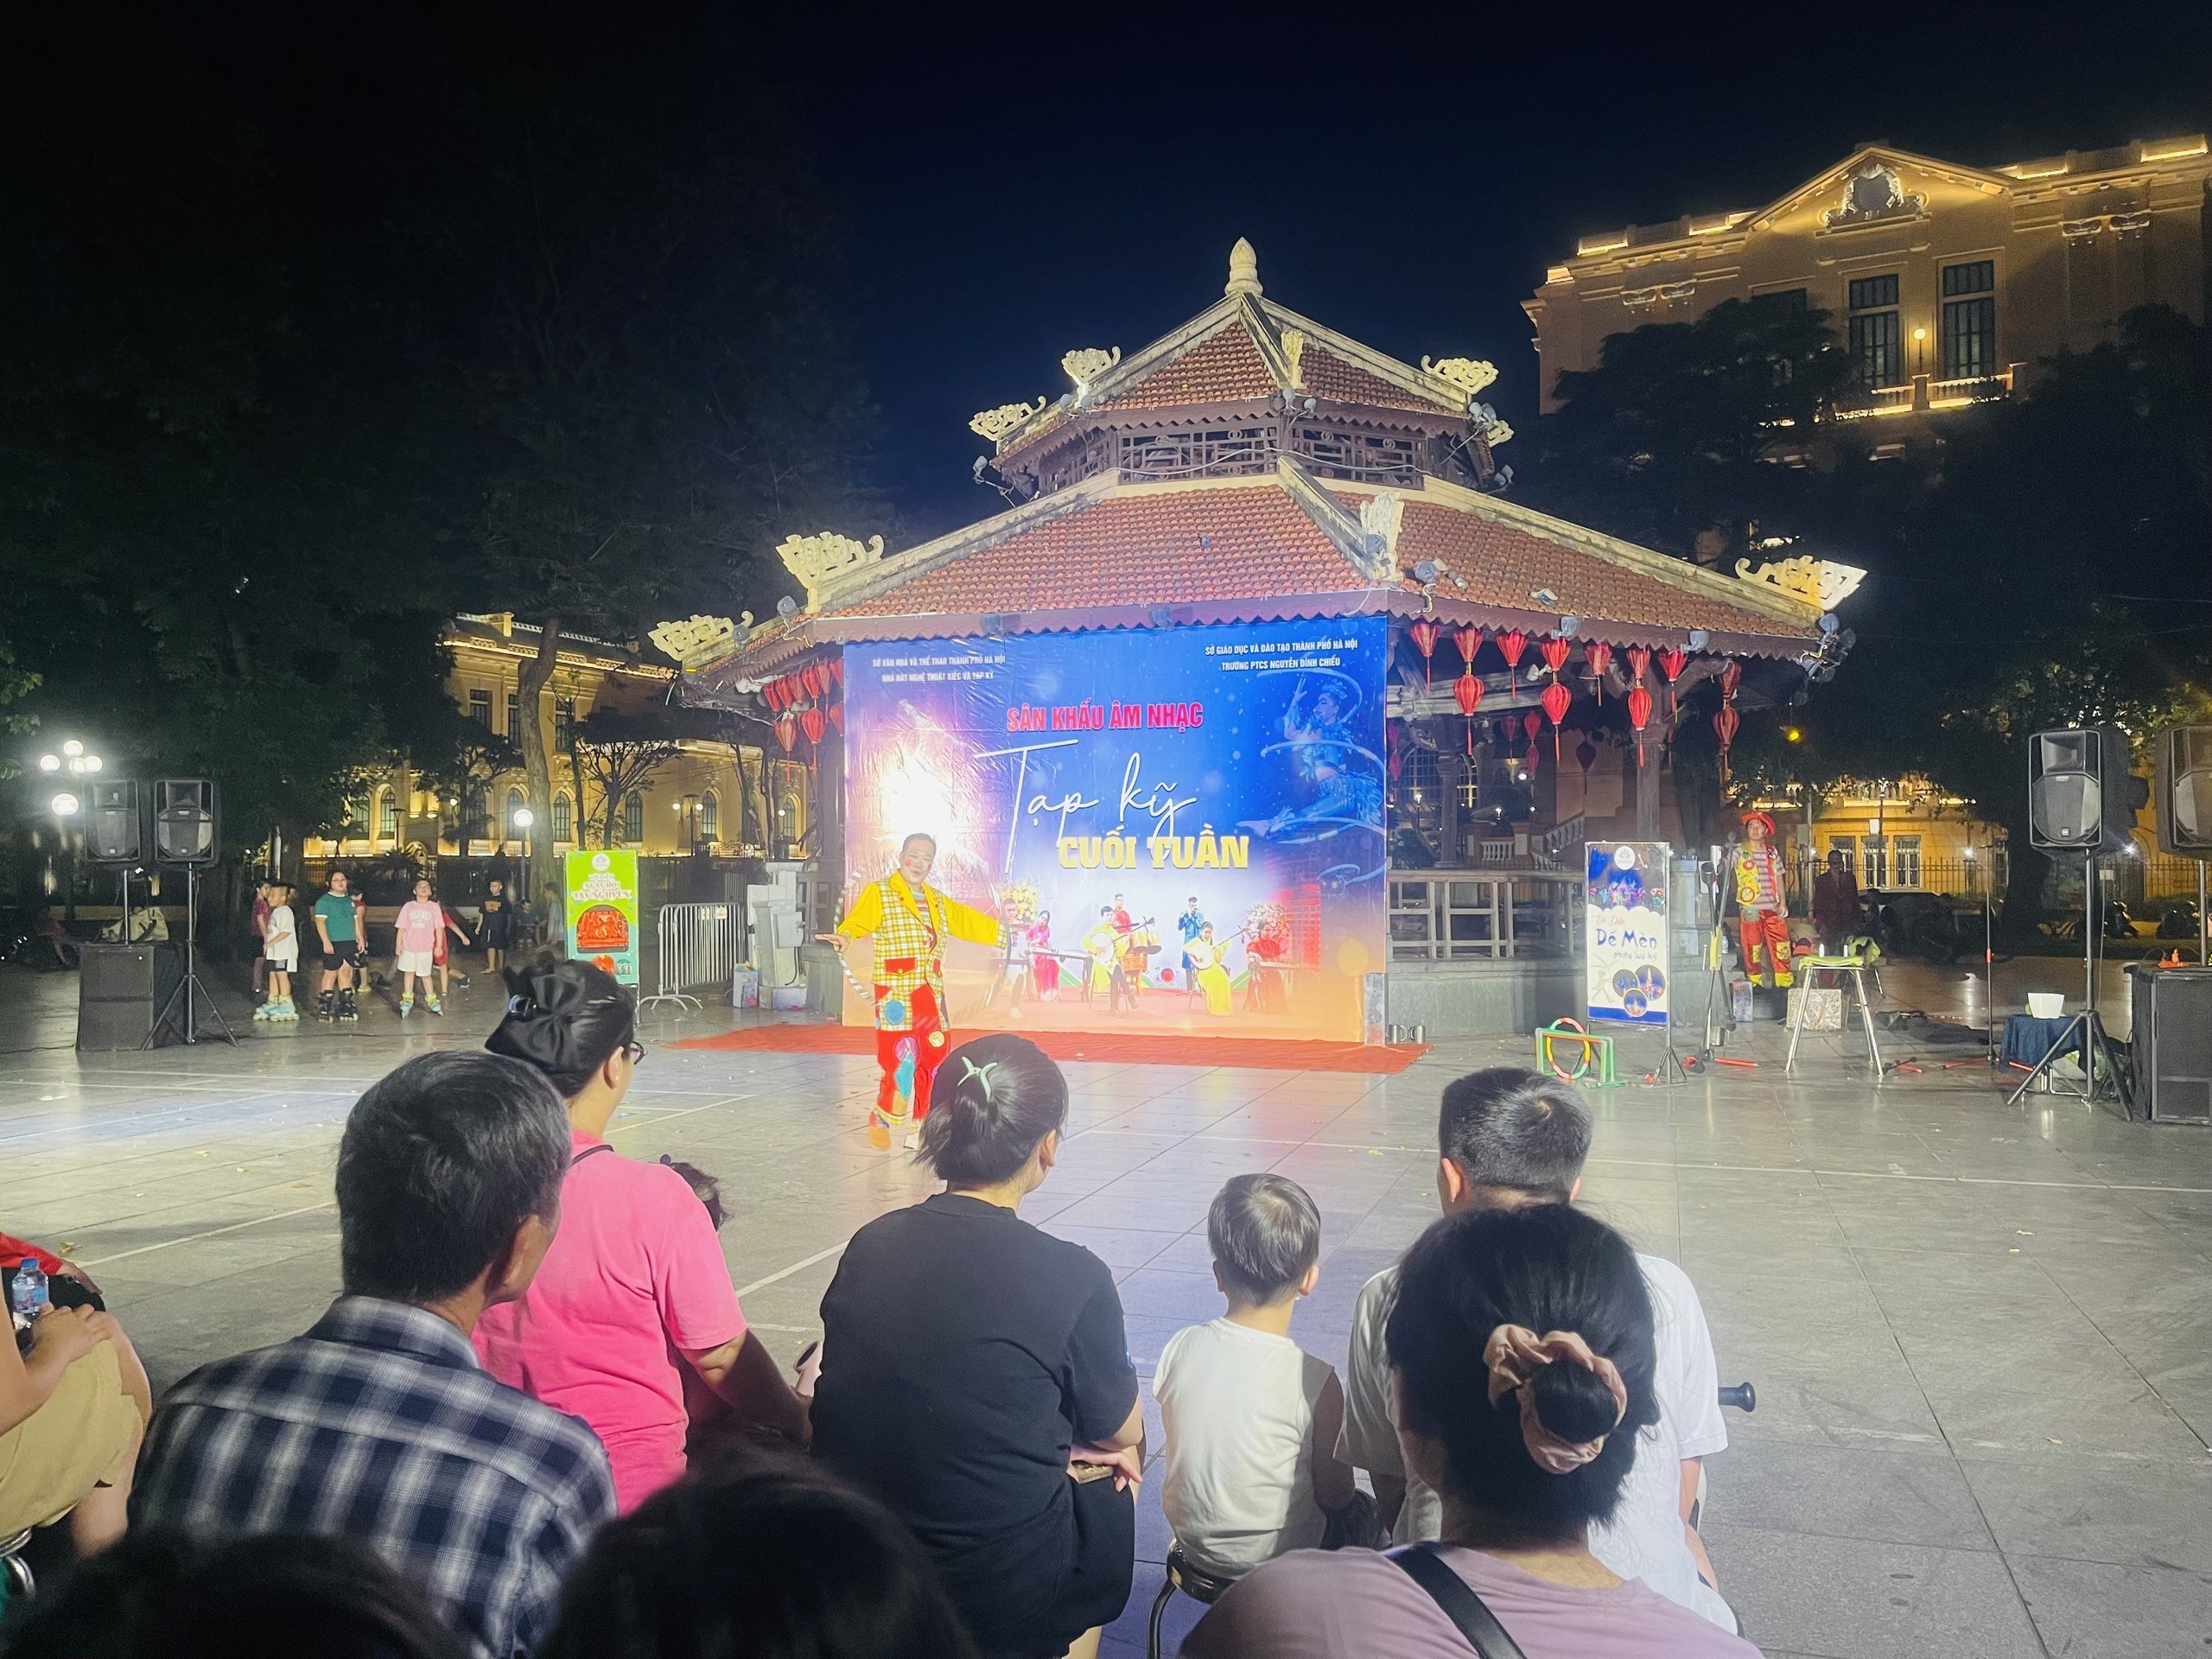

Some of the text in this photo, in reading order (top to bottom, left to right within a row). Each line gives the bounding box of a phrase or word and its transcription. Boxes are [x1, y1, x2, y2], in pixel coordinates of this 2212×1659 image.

[1205, 638, 1357, 656] SỞ GIÁO DỤC VÀ ĐÀO TẠO THÀNH PHỐ HÀ NỘI
[882, 657, 894, 667] VĂN
[909, 656, 918, 666] VÀ
[919, 655, 931, 666] THỂ
[931, 657, 947, 666] THAO
[949, 655, 969, 665] THÀNH
[970, 653, 983, 664] PHỐ
[984, 654, 993, 664] HÀ
[995, 653, 1006, 664] NỘI
[1222, 654, 1340, 671] TRƯỜNG PTCS NGUYỄN ĐÌNH CHIỂU
[882, 673, 894, 683] NHÀ
[909, 671, 925, 683] NGHỆ
[927, 671, 945, 683] THUẬT
[947, 670, 961, 681] XIẾC
[963, 671, 971, 681] VÀ
[1007, 698, 1204, 733] SÂN KHẤU ÂM NHẠC
[973, 739, 1198, 874] Tạp kỹ
[1058, 823, 1249, 869] CUỐI TUẦN
[1596, 928, 1657, 950] Dế Mèn
